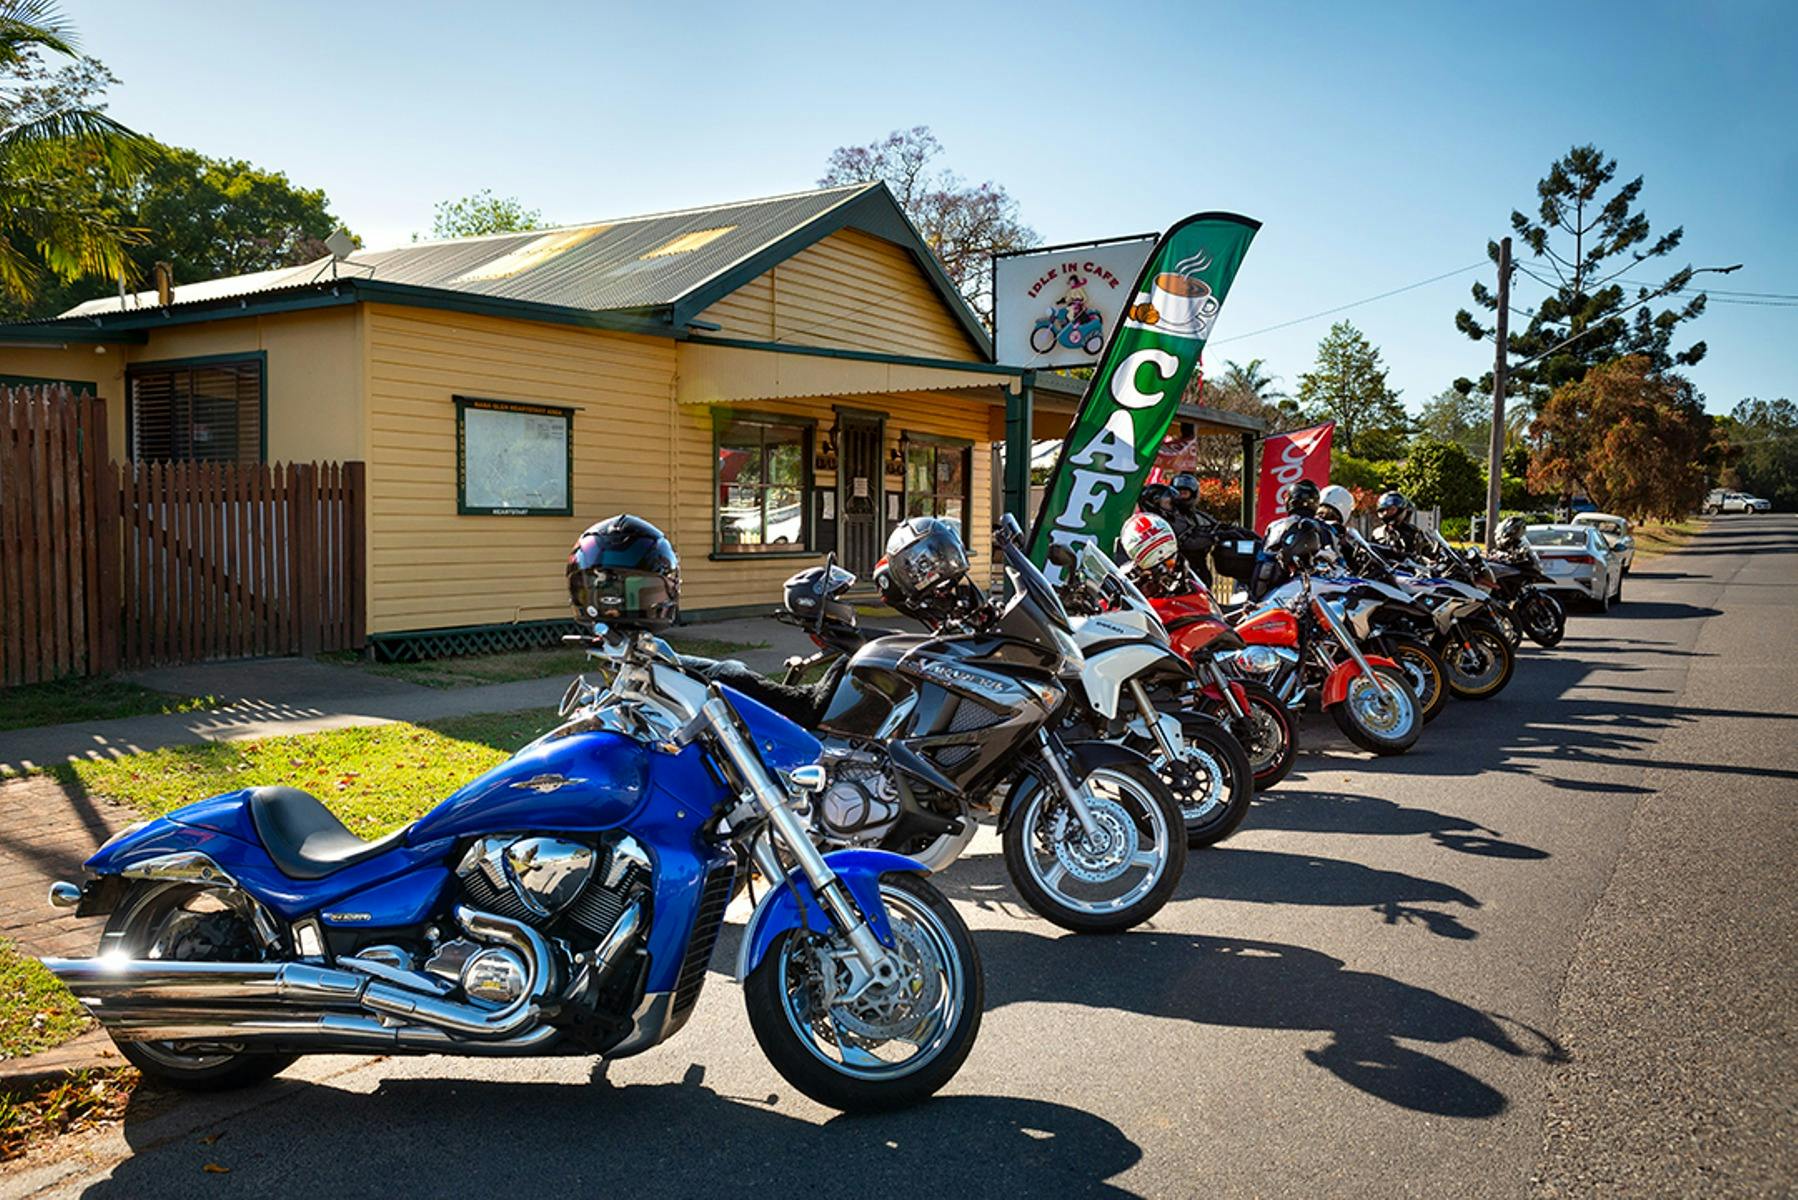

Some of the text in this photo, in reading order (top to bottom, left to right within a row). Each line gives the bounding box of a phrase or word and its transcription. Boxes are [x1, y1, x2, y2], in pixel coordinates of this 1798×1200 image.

[1027, 261, 1120, 299] IDLE IN CAFE
